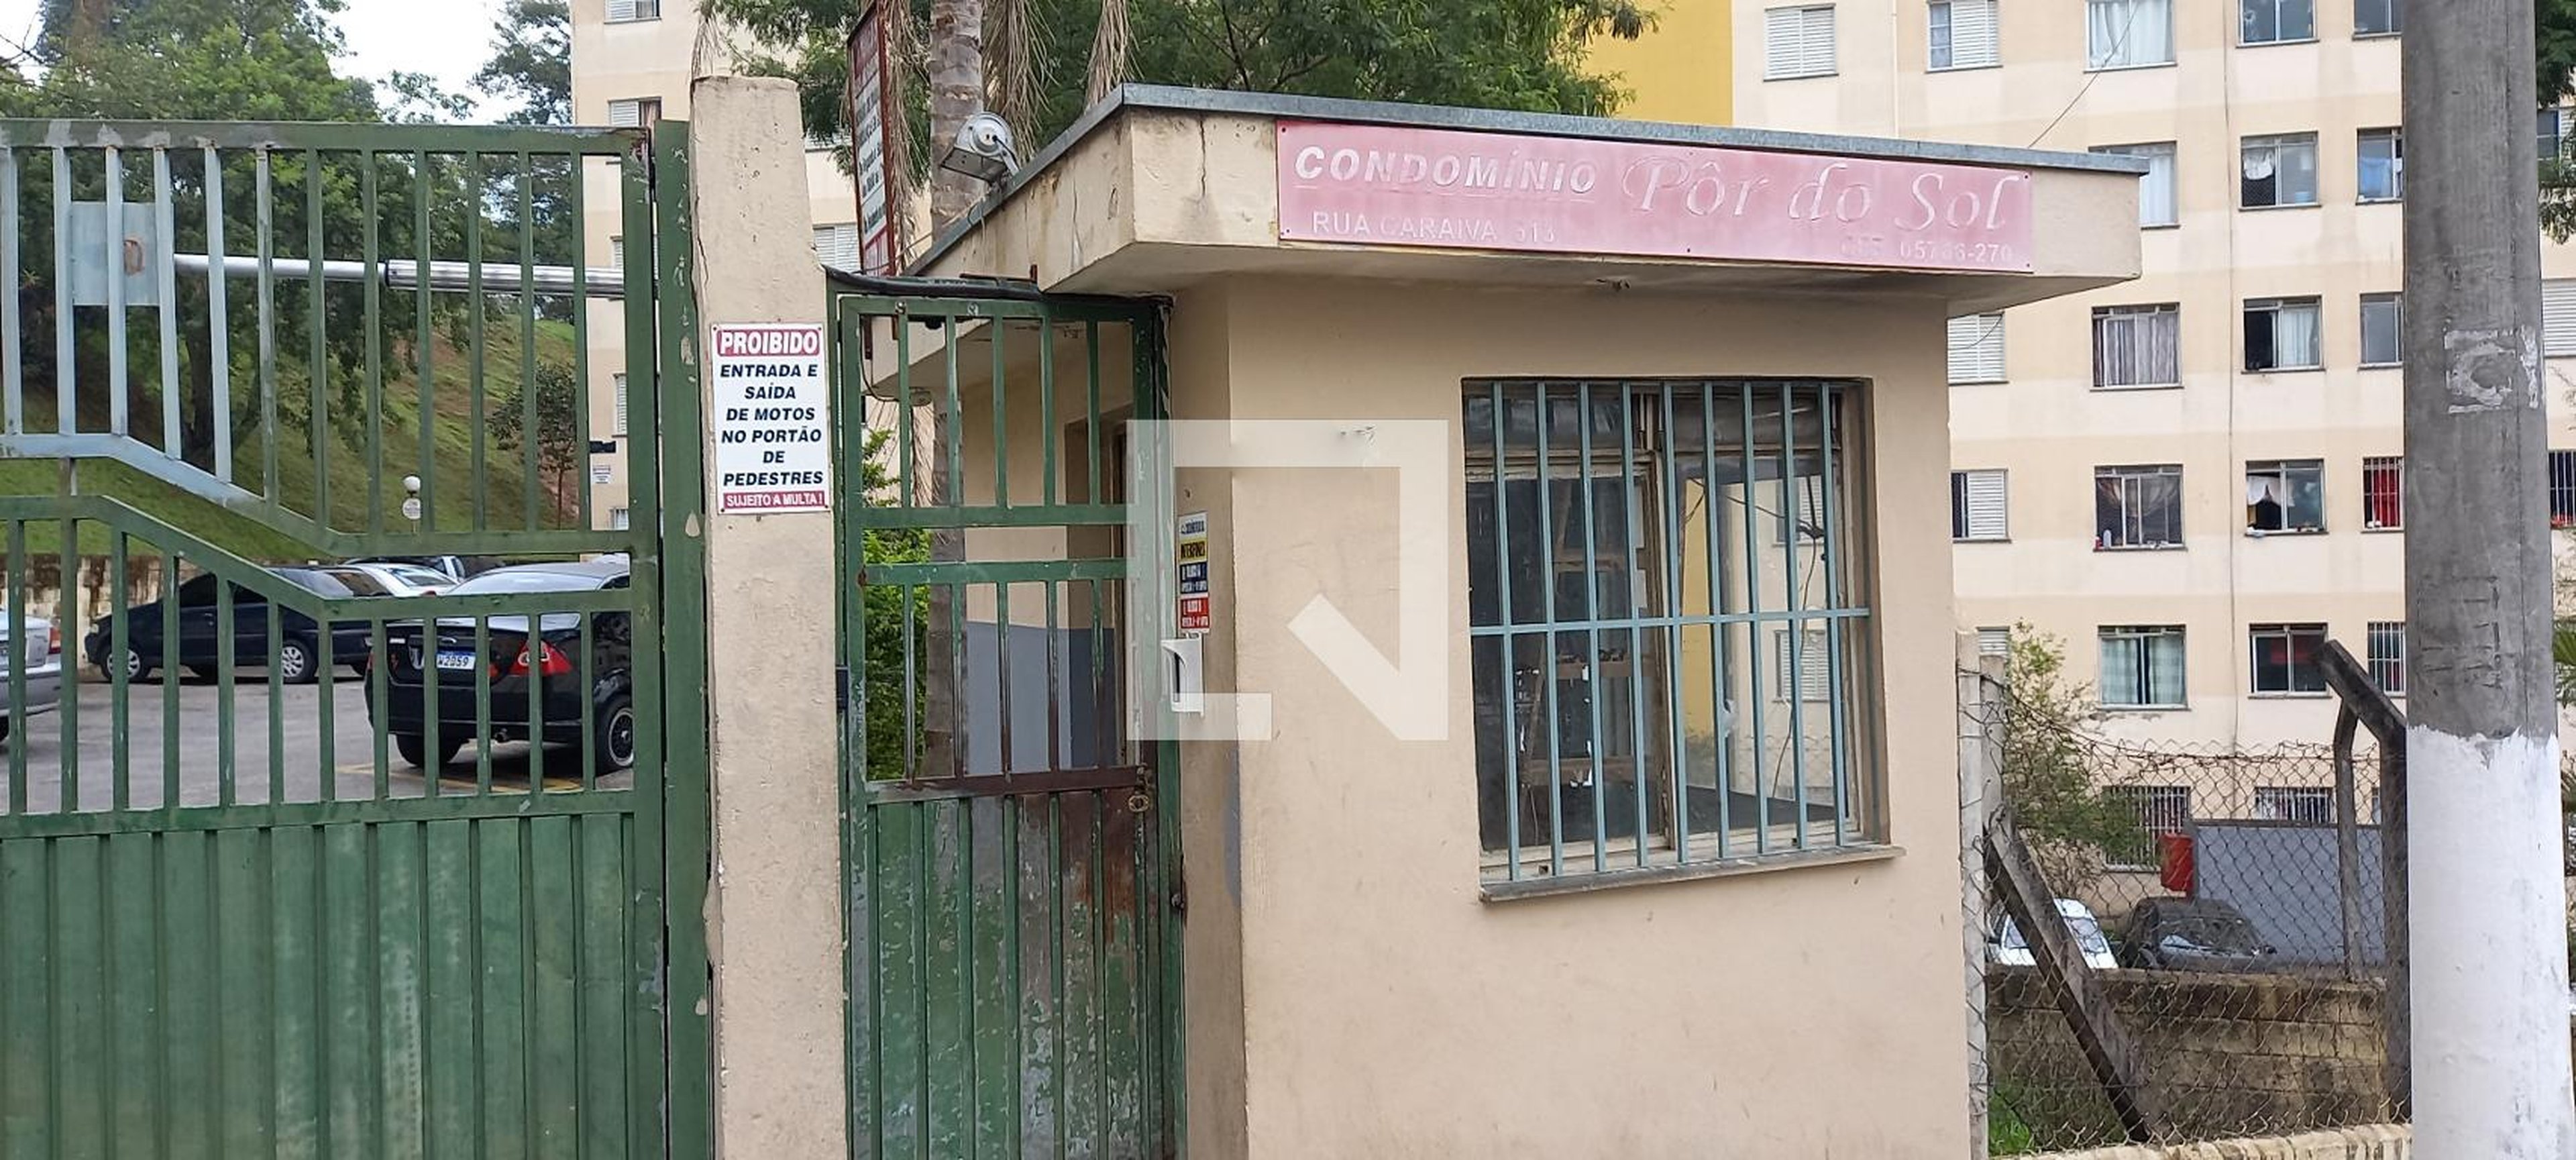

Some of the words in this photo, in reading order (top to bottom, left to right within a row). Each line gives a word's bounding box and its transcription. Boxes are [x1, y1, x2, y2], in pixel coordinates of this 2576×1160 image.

[1294, 145, 1597, 193] CONDOMÍNIO
[1621, 156, 1770, 217] Pôr
[1788, 162, 1872, 222] do
[1893, 172, 2019, 231] Sol
[1312, 210, 1371, 235] RUA
[719, 330, 819, 355] PROIBIDO
[720, 364, 802, 378] ENTRADA
[807, 364, 818, 377] E
[744, 382, 796, 400] SAÍDA
[726, 408, 749, 421] DE
[754, 407, 816, 421] MOTOS
[721, 429, 747, 443] NO
[751, 425, 822, 443] PORTÃO
[762, 451, 786, 464] DE
[723, 471, 824, 486] PEDESTRES
[727, 494, 771, 507] SUJEITO
[773, 494, 782, 506] A
